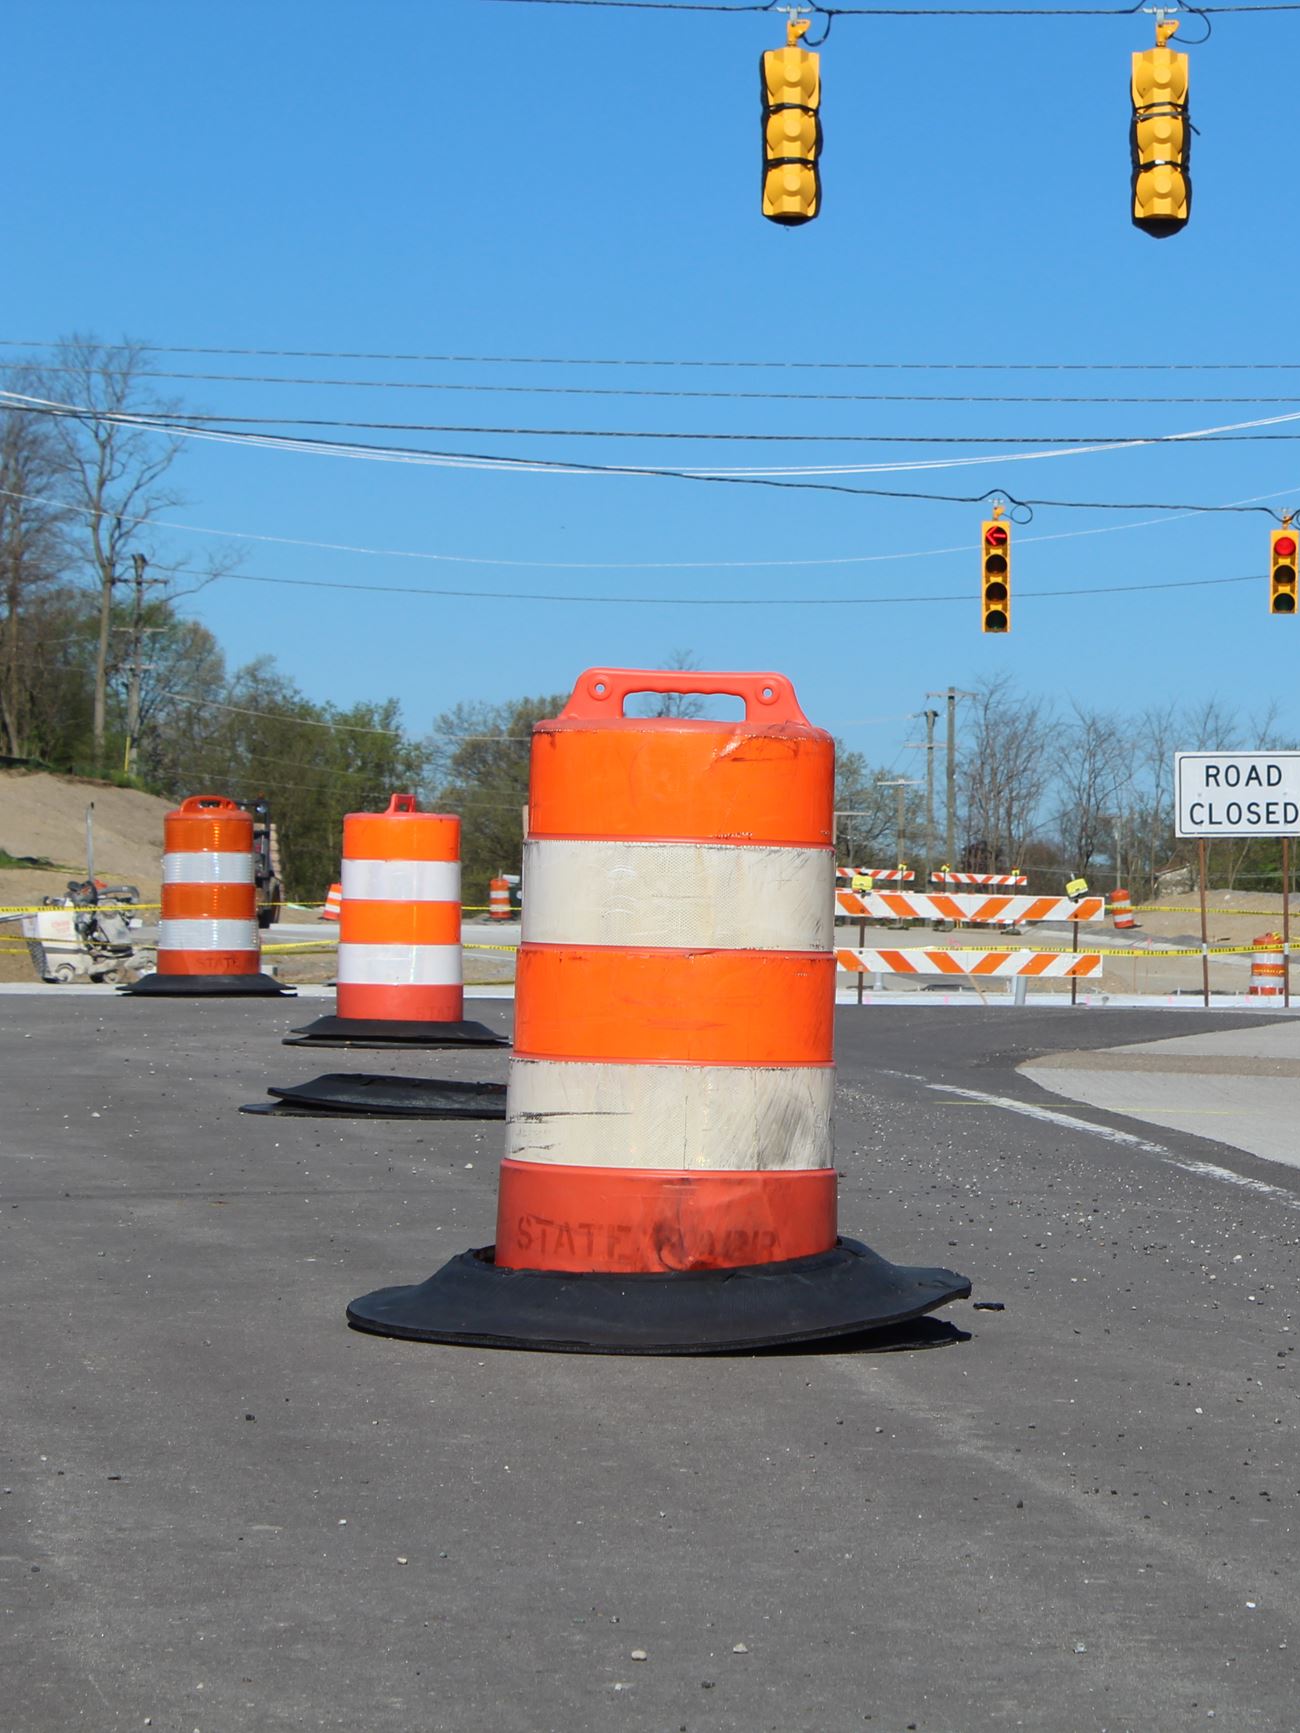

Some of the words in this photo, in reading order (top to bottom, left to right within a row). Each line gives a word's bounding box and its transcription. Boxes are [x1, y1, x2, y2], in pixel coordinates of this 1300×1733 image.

[1206, 765, 1282, 788] ROAD
[1189, 802, 1299, 825] CLOSED
[518, 1213, 632, 1260] STATE
